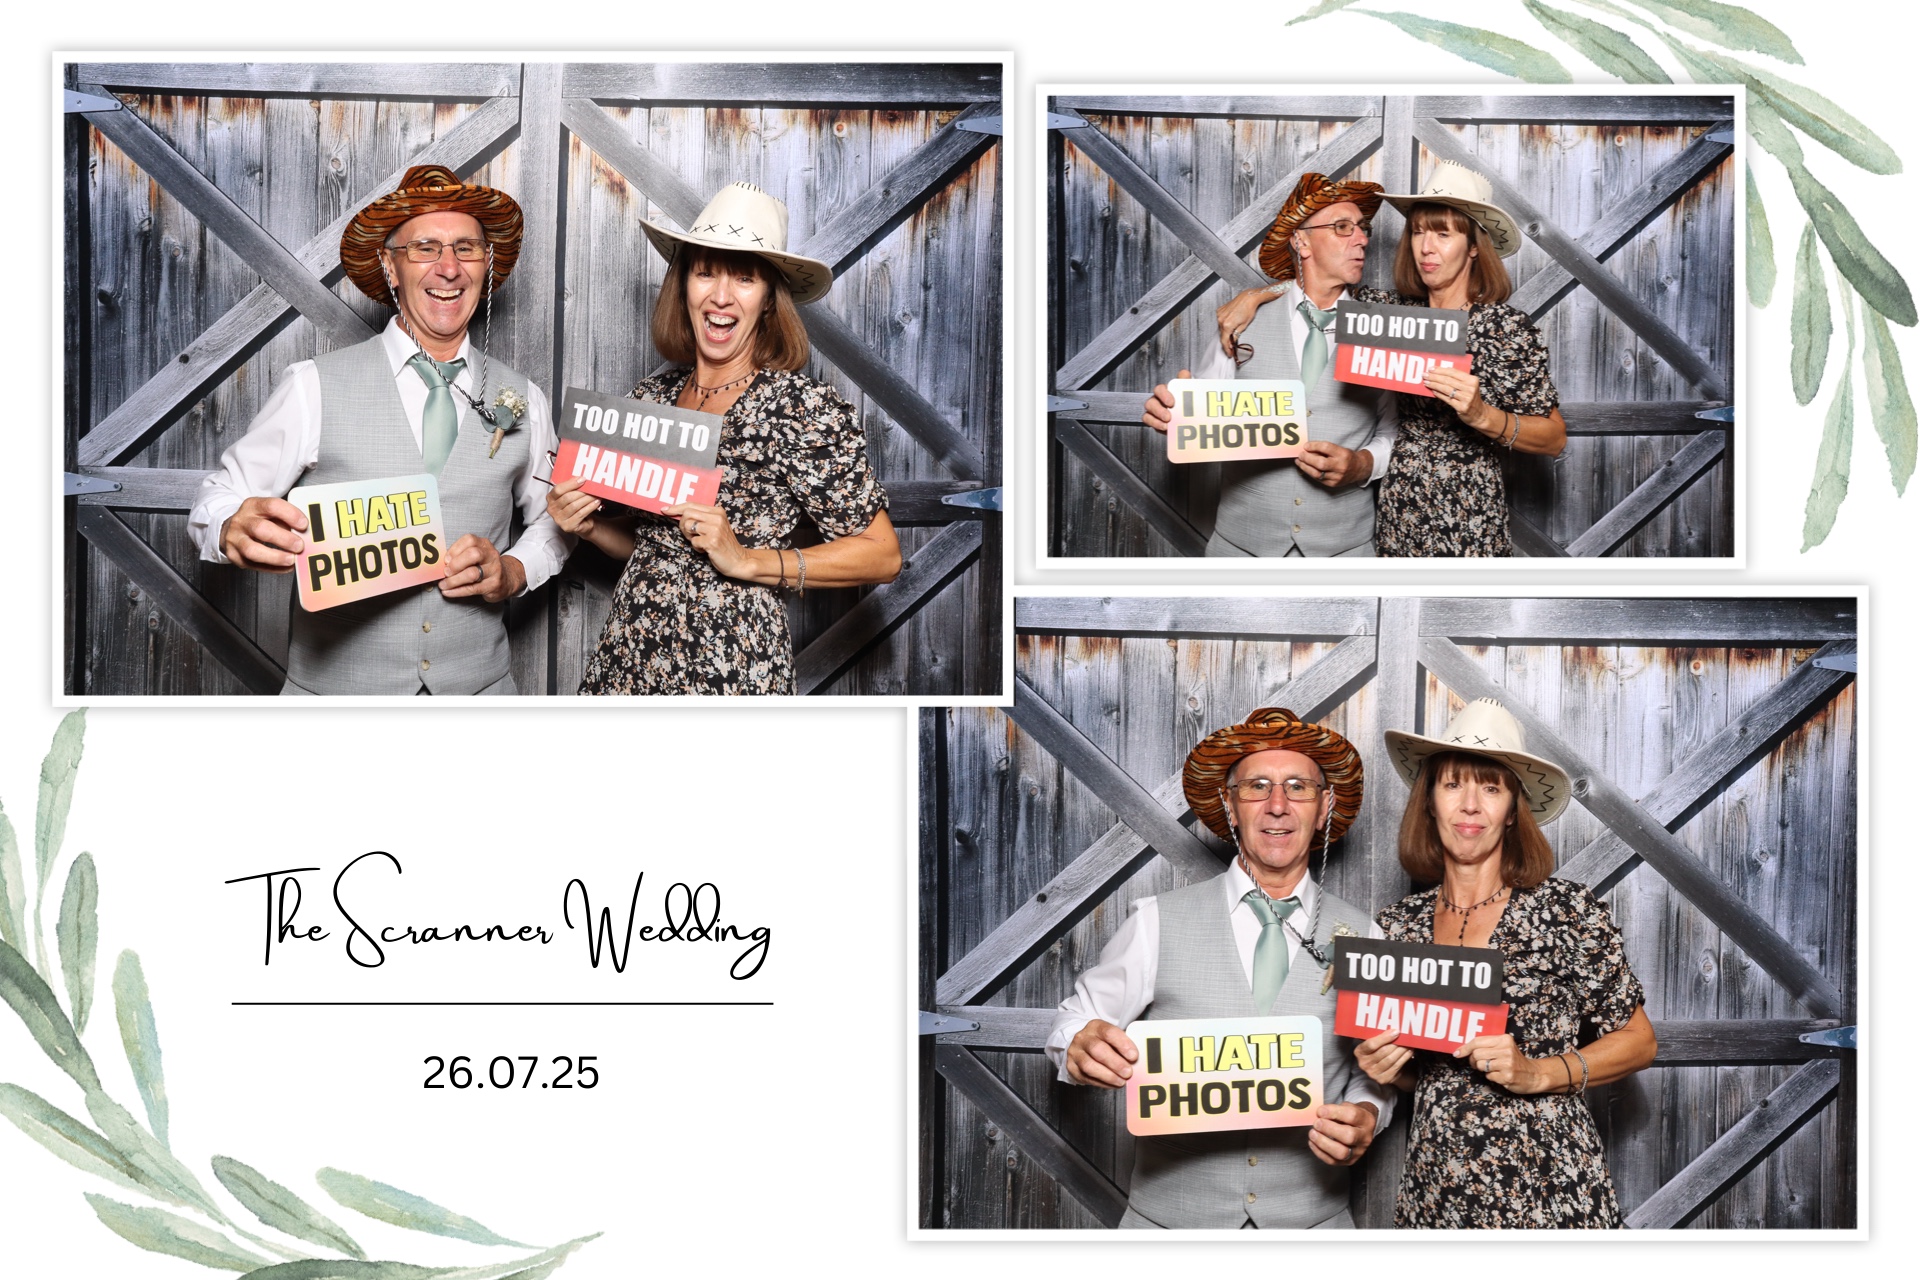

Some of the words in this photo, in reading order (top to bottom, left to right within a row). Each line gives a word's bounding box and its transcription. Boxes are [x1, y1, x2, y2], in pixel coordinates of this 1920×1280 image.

[1345, 312, 1384, 336] TOO
[1388, 316, 1429, 339] HOT
[1433, 319, 1459, 342] TO
[1350, 345, 1454, 385] HAND
[1182, 391, 1194, 417] I
[1206, 390, 1294, 417] HATE
[573, 403, 620, 435] TOO
[622, 412, 674, 445] HOT
[678, 421, 710, 452] TO
[1177, 422, 1300, 450] PHOTOS
[571, 443, 699, 506] HANDLE
[308, 503, 326, 542] I
[335, 490, 430, 538] HATE
[308, 533, 440, 592] PHOTOS
[1345, 952, 1396, 982] TOO
[1401, 956, 1454, 986] HOT
[1459, 960, 1492, 989] TO
[1355, 992, 1486, 1044] HANDLE
[1146, 1037, 1162, 1073] I
[1179, 1033, 1305, 1073] HATE
[1139, 1077, 1312, 1119] PHOTOS
